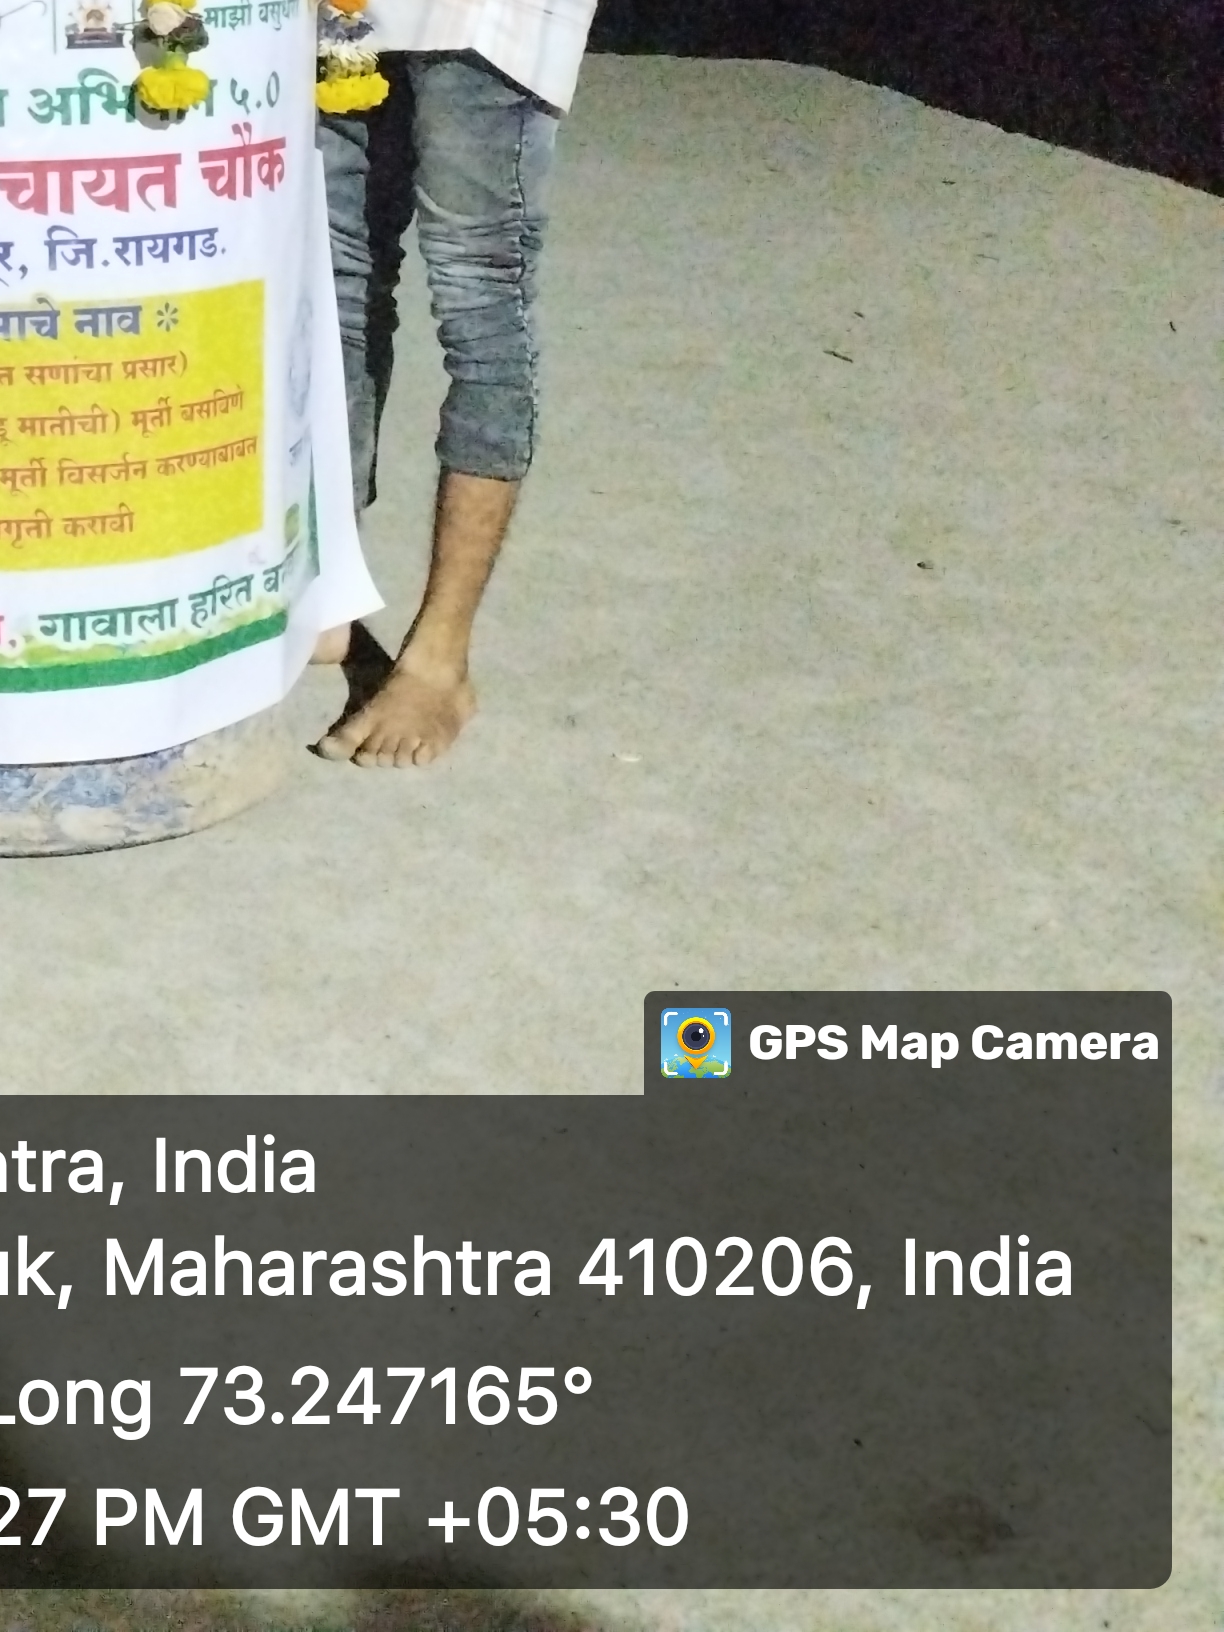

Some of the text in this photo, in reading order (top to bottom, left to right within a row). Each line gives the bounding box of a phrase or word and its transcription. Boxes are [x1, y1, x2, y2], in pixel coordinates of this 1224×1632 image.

[198, 121, 286, 201] चौक
[73, 305, 142, 338] नाव
[122, 350, 188, 381] प्रसार)
[57, 451, 148, 486] विसर्जन
[62, 501, 135, 538] करावी
[38, 597, 179, 643] गावाला
[189, 575, 255, 629] हरित
